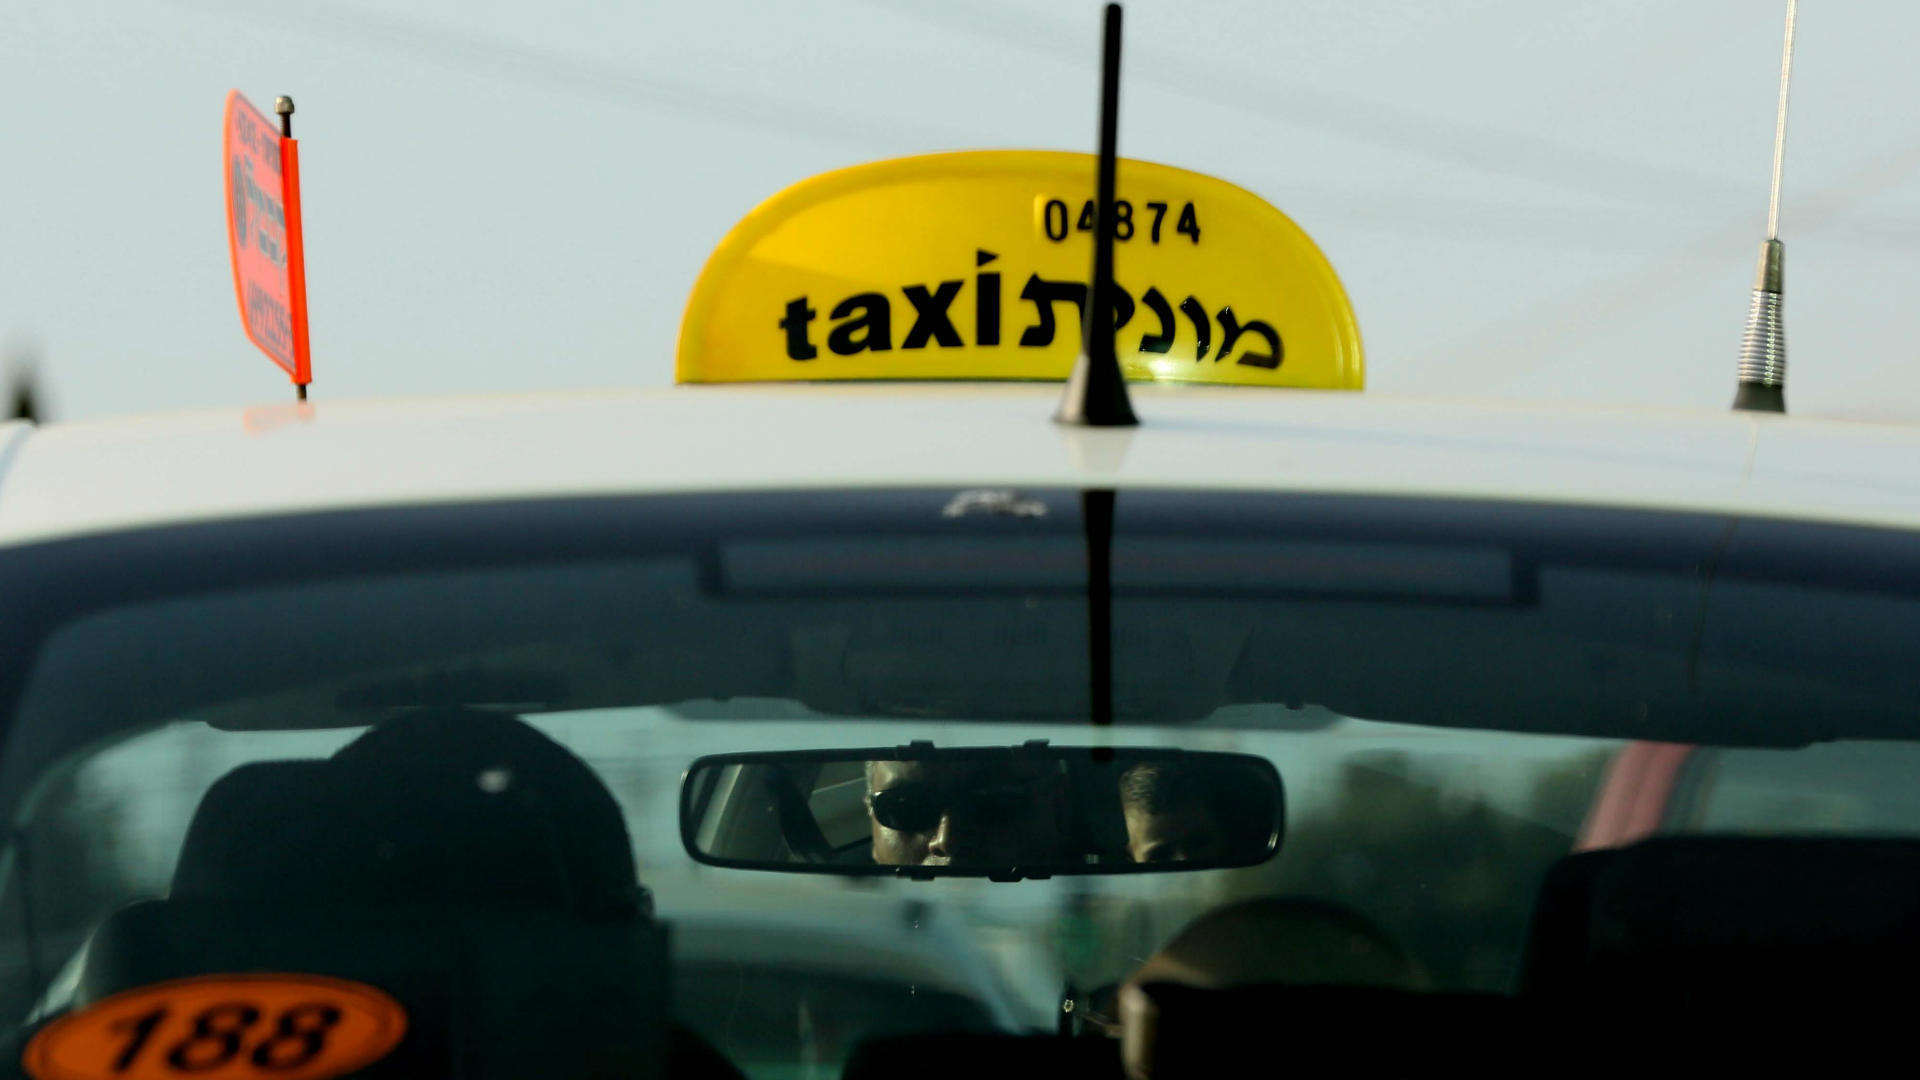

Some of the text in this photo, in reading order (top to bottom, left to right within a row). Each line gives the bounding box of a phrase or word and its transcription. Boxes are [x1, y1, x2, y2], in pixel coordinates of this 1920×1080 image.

[1043, 198, 1201, 245] 04874
[779, 249, 1001, 361] taxi
[109, 1002, 343, 1073] 188
